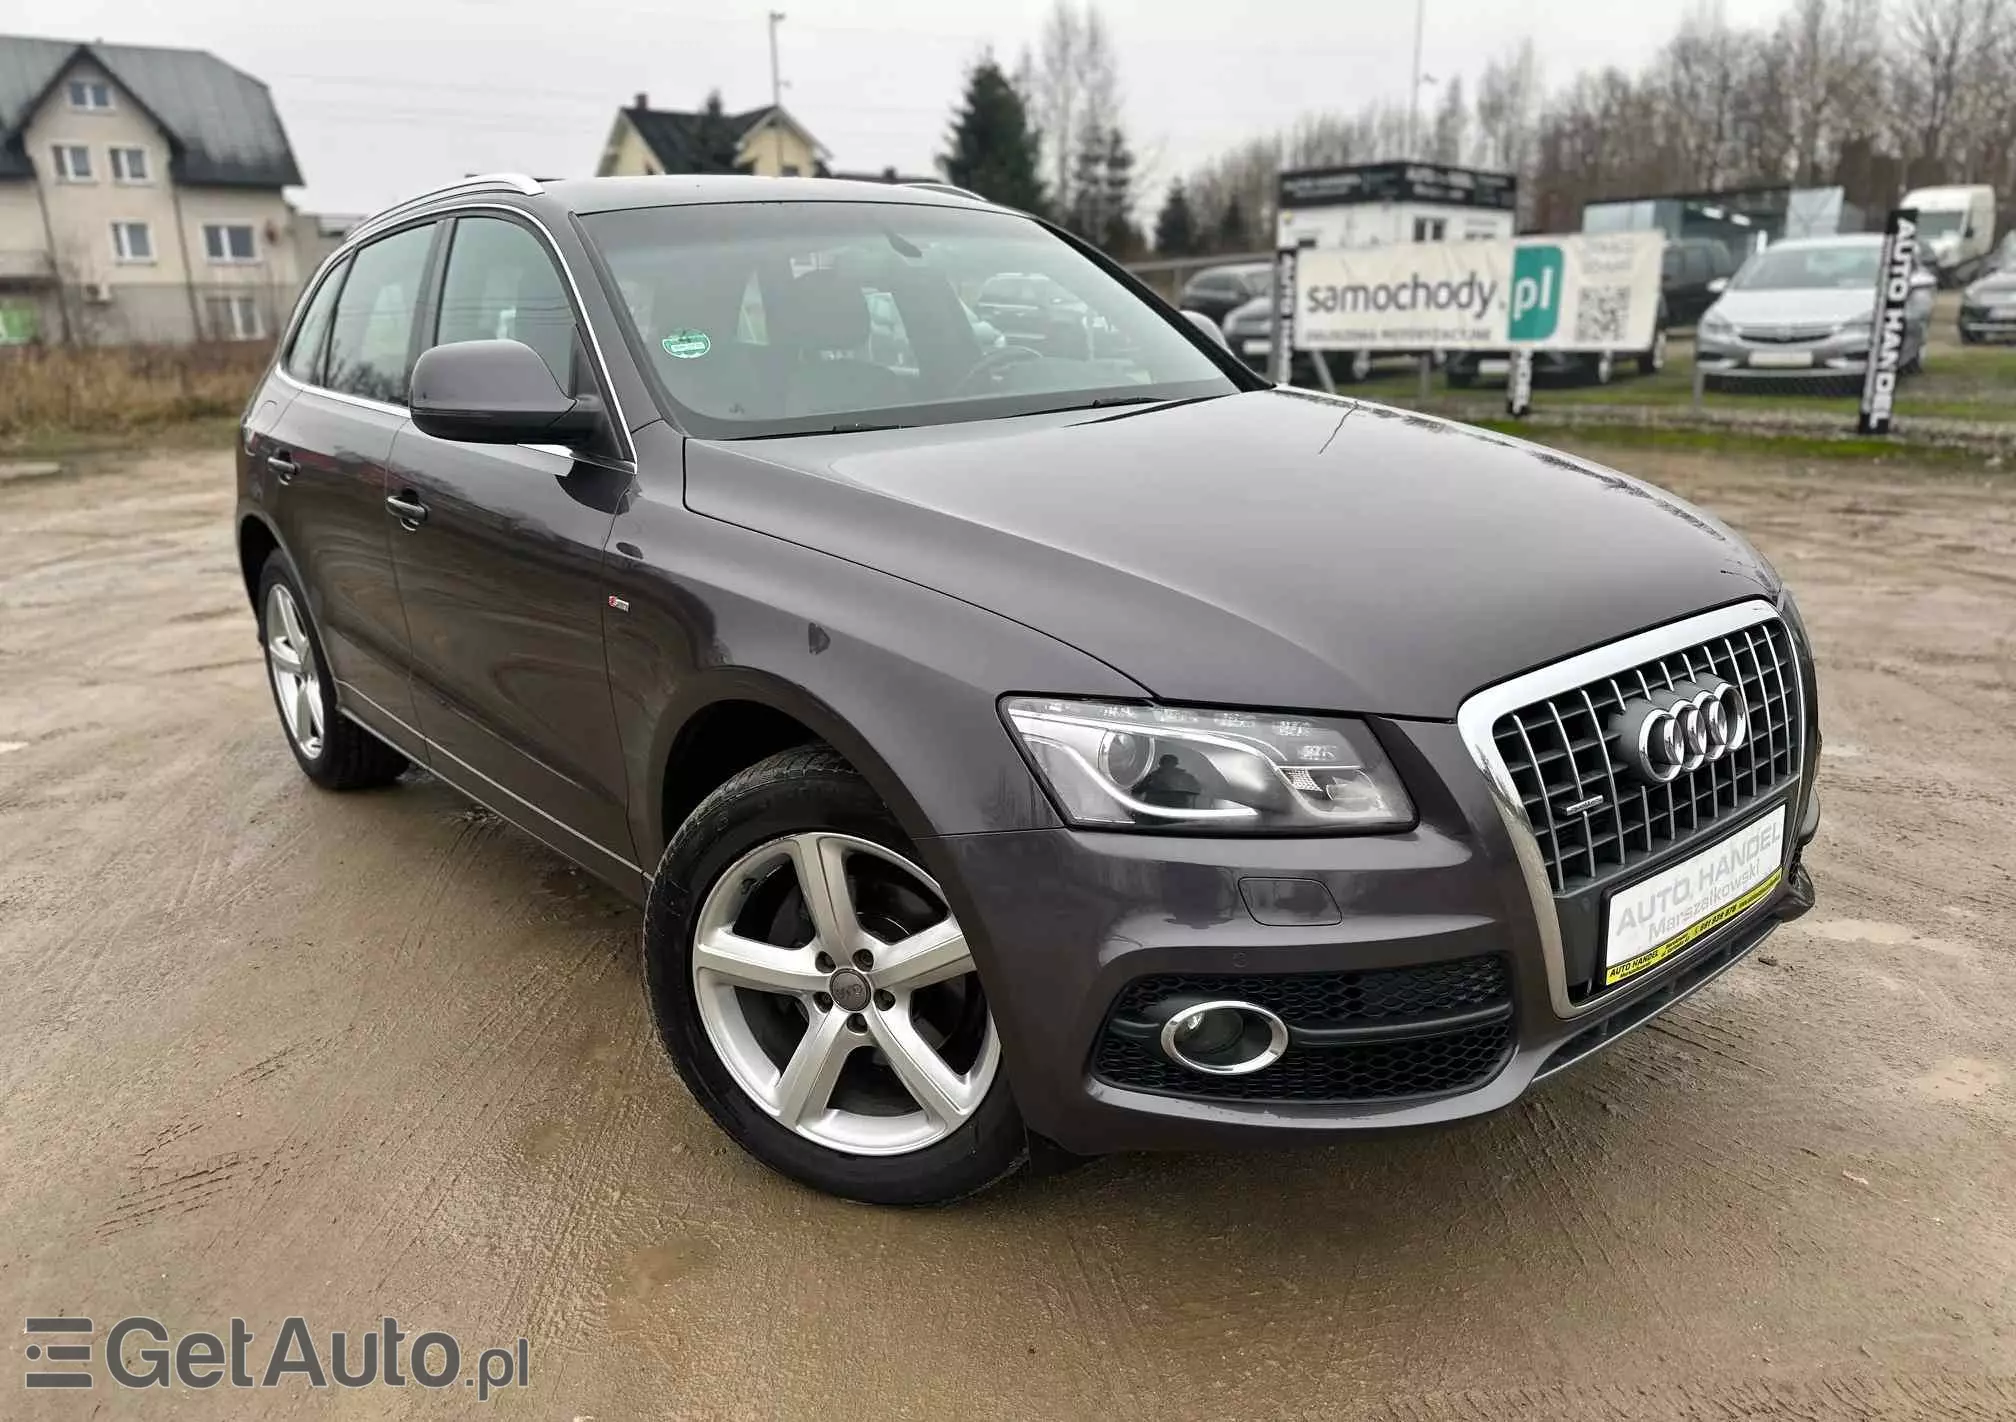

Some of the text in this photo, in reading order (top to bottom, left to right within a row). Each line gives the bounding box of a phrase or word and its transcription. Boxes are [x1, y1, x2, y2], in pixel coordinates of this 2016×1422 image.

[1869, 217, 1918, 429] AUTO HANDEL
[1616, 877, 1691, 937] AUTO
[1699, 821, 1781, 890] HANDEL
[1609, 962, 1631, 977] AUTO
